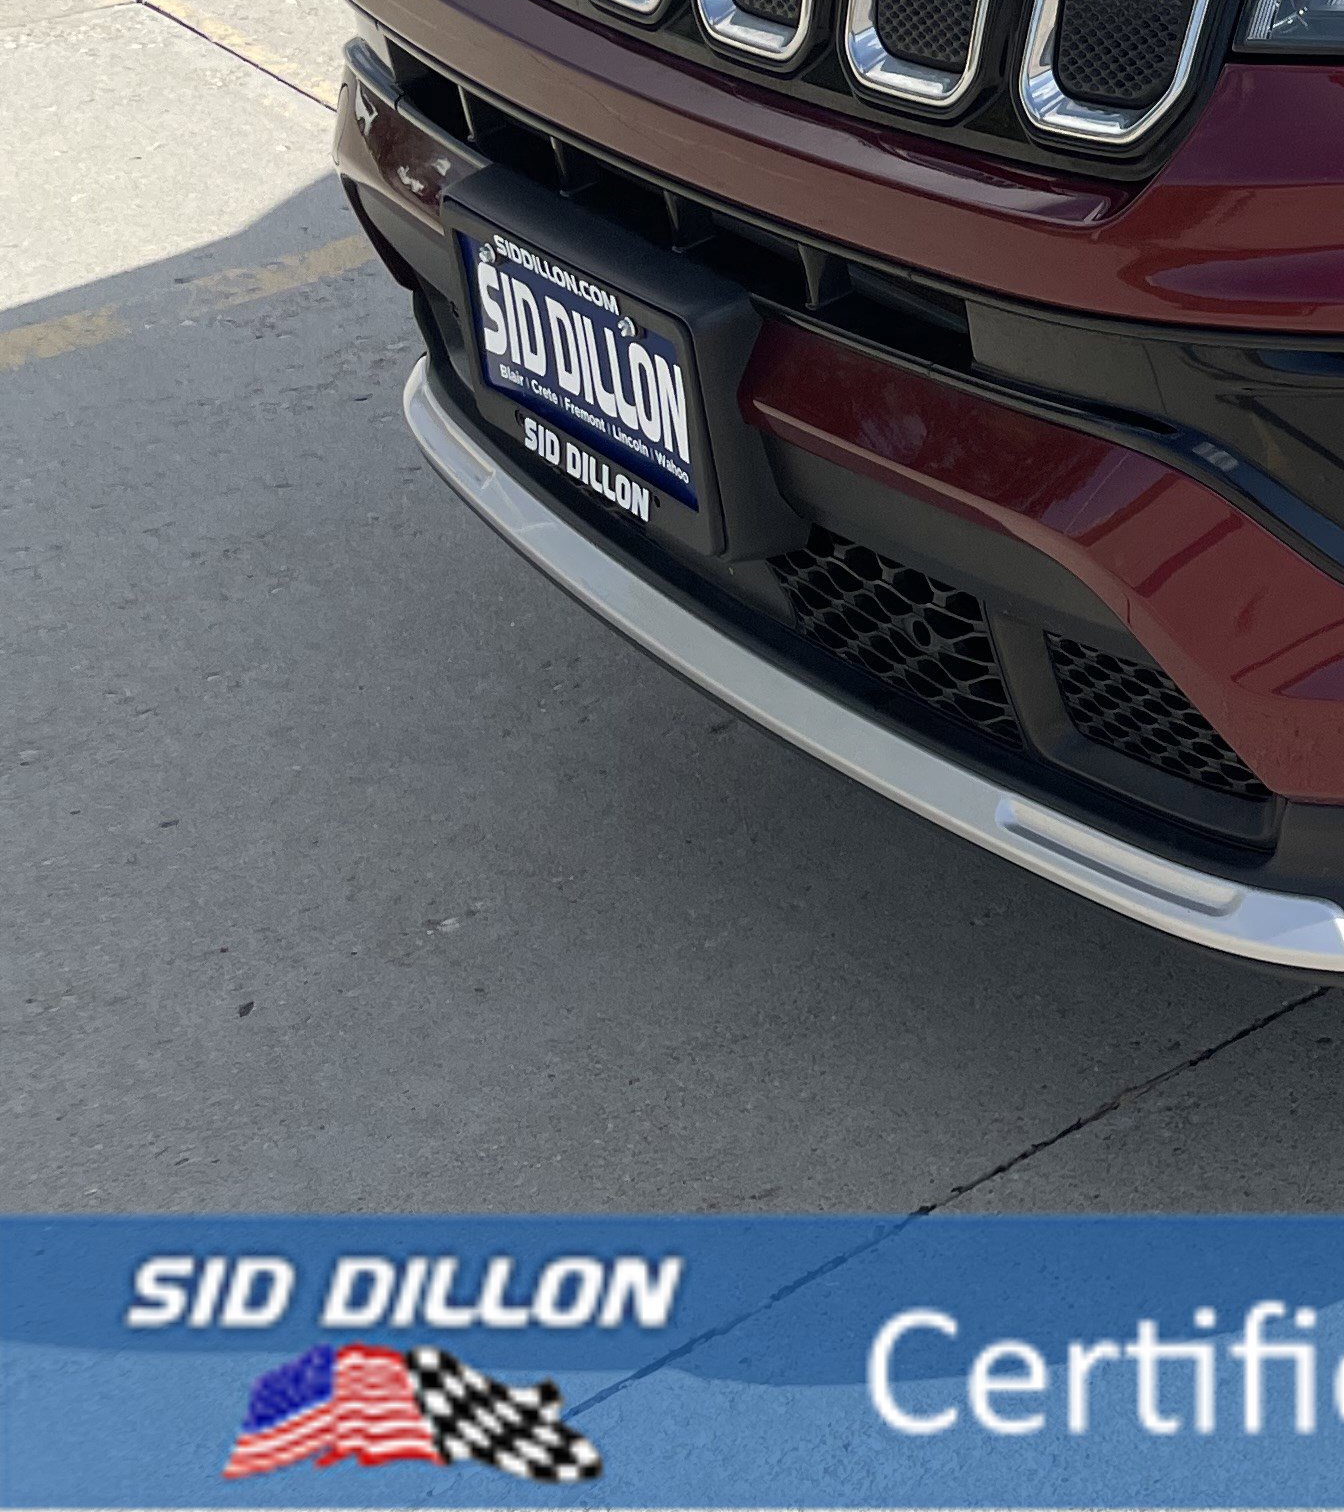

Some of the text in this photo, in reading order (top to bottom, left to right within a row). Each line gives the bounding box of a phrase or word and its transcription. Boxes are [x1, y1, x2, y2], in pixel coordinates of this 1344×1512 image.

[493, 234, 620, 317] SIDDILLON.COM
[477, 260, 691, 465] SID DILLON
[500, 363, 690, 484] Blair Crete Fremont Lincoln Wahoo
[524, 417, 650, 523] SID DILLON
